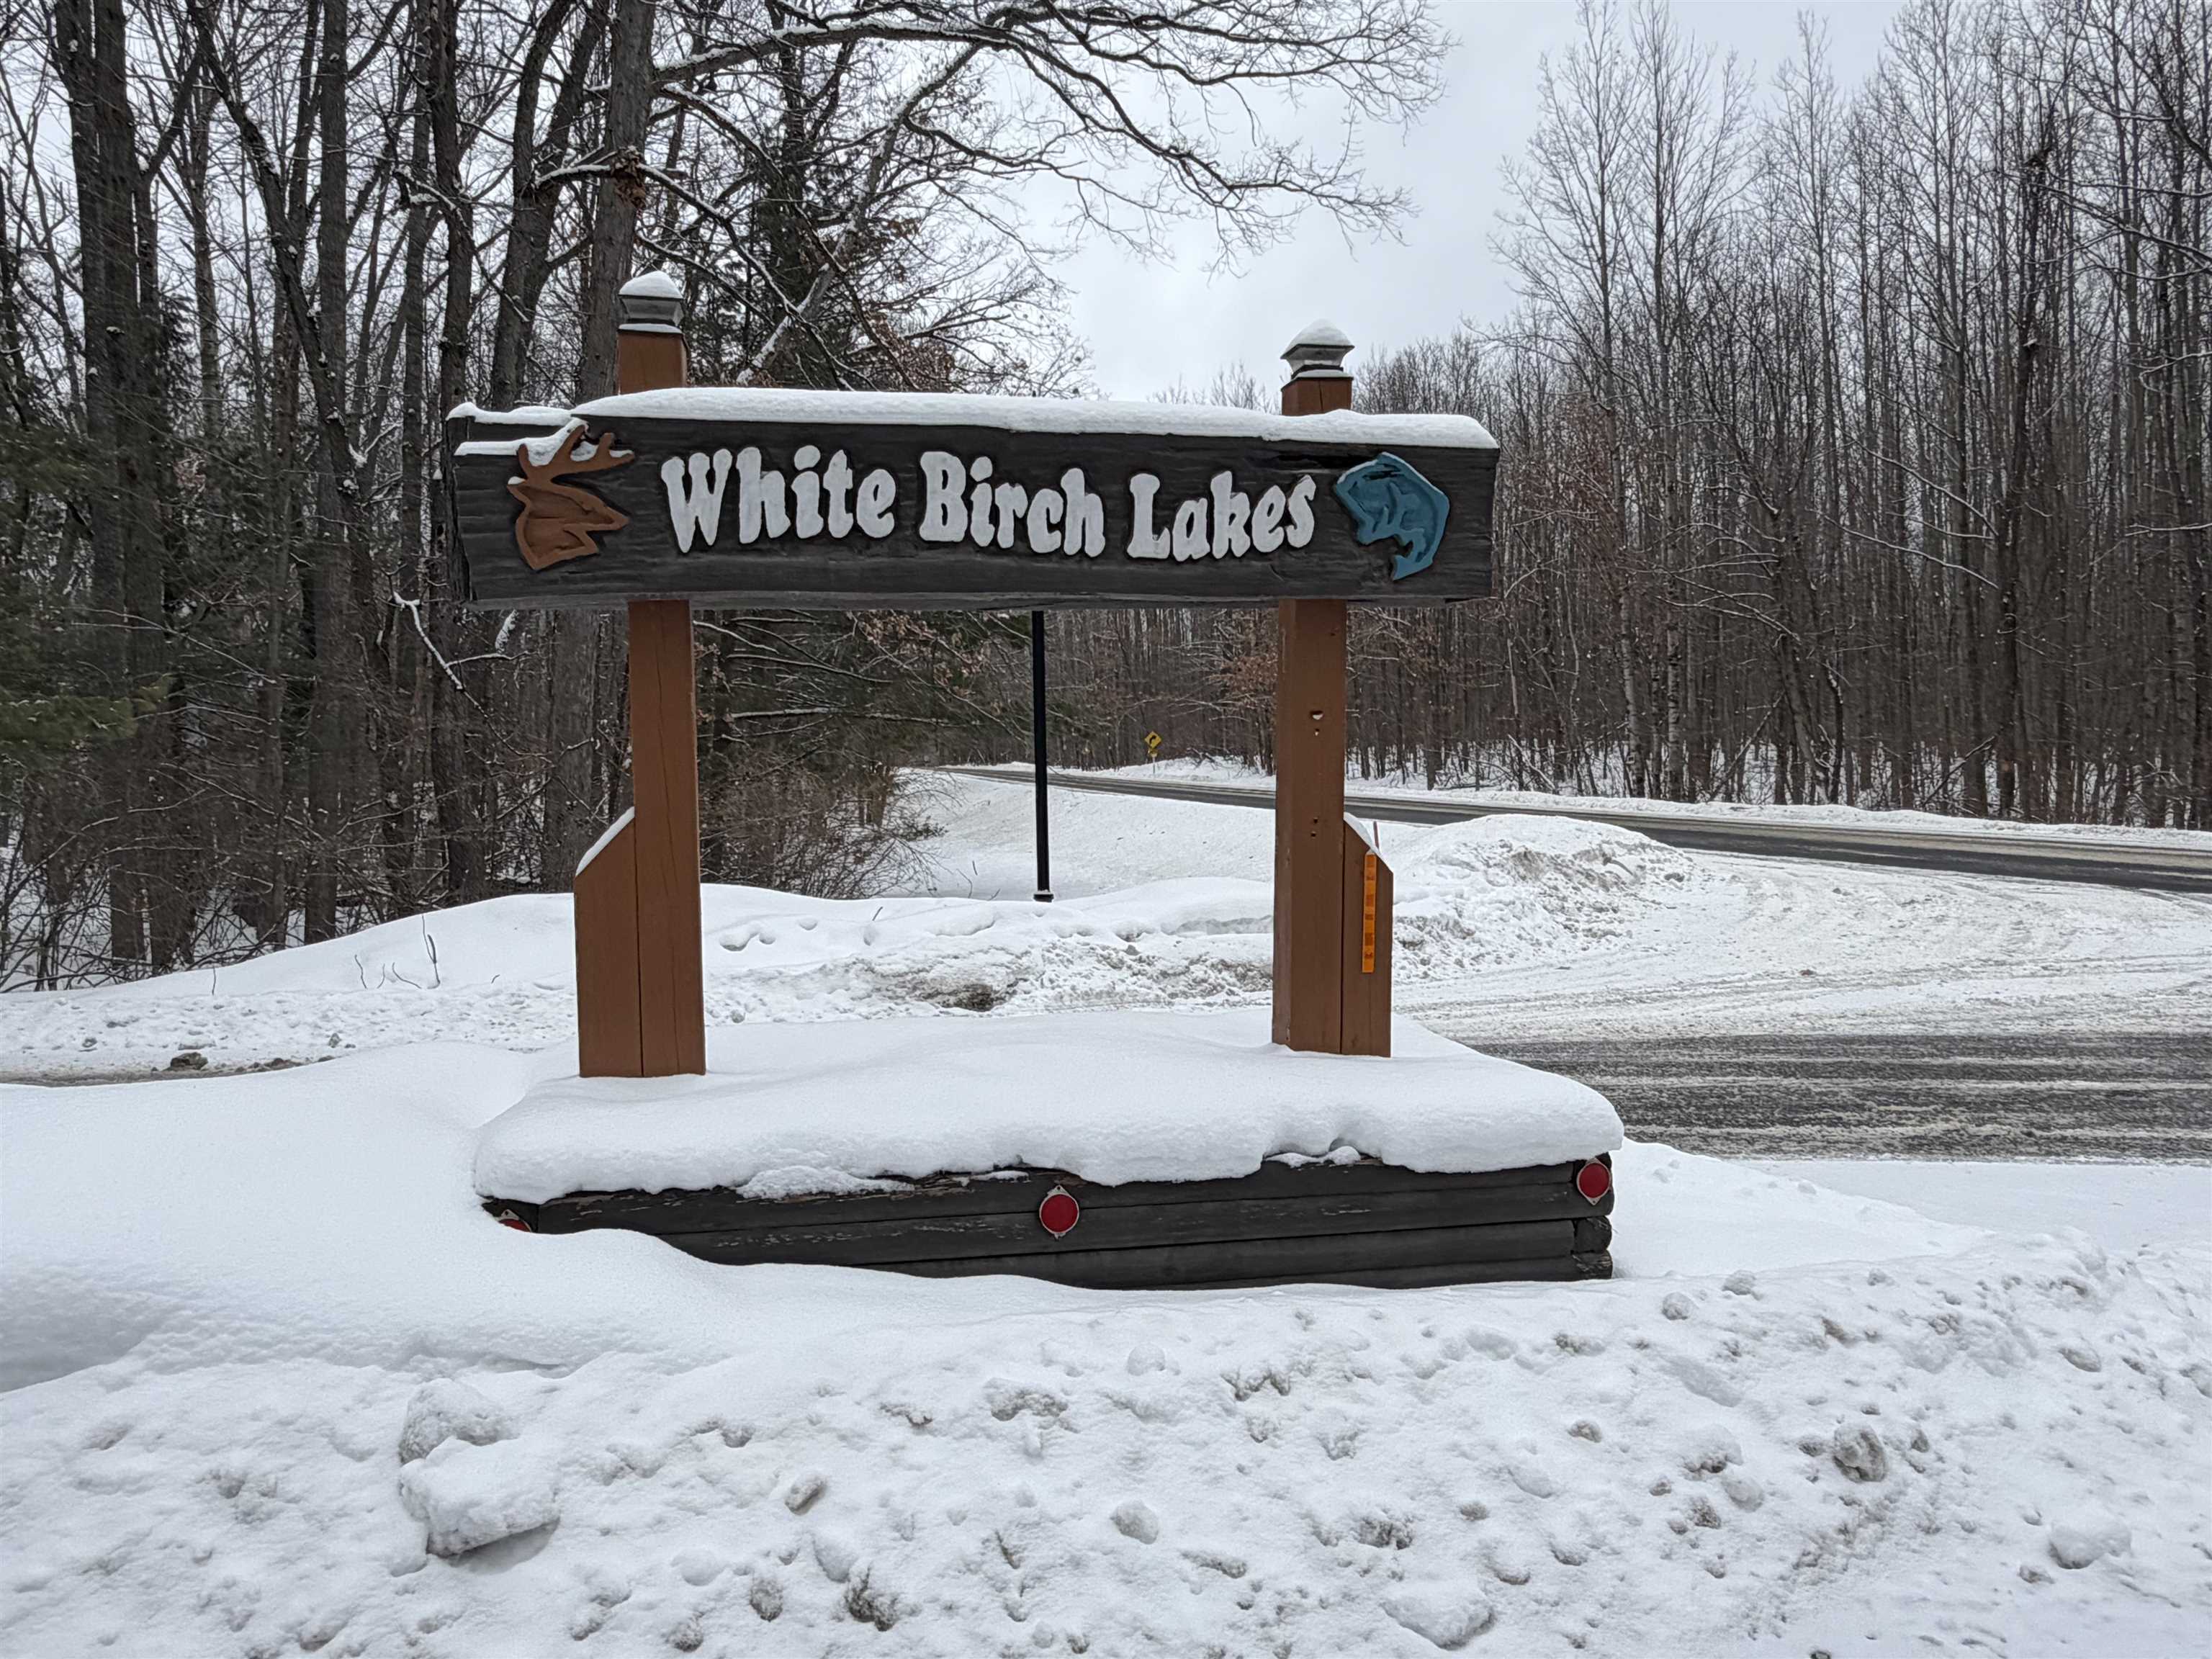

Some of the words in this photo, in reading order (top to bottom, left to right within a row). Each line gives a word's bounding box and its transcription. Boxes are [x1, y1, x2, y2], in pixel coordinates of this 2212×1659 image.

[660, 444, 897, 553] White
[918, 451, 1106, 557] Birch
[1126, 470, 1317, 562] Lakes
